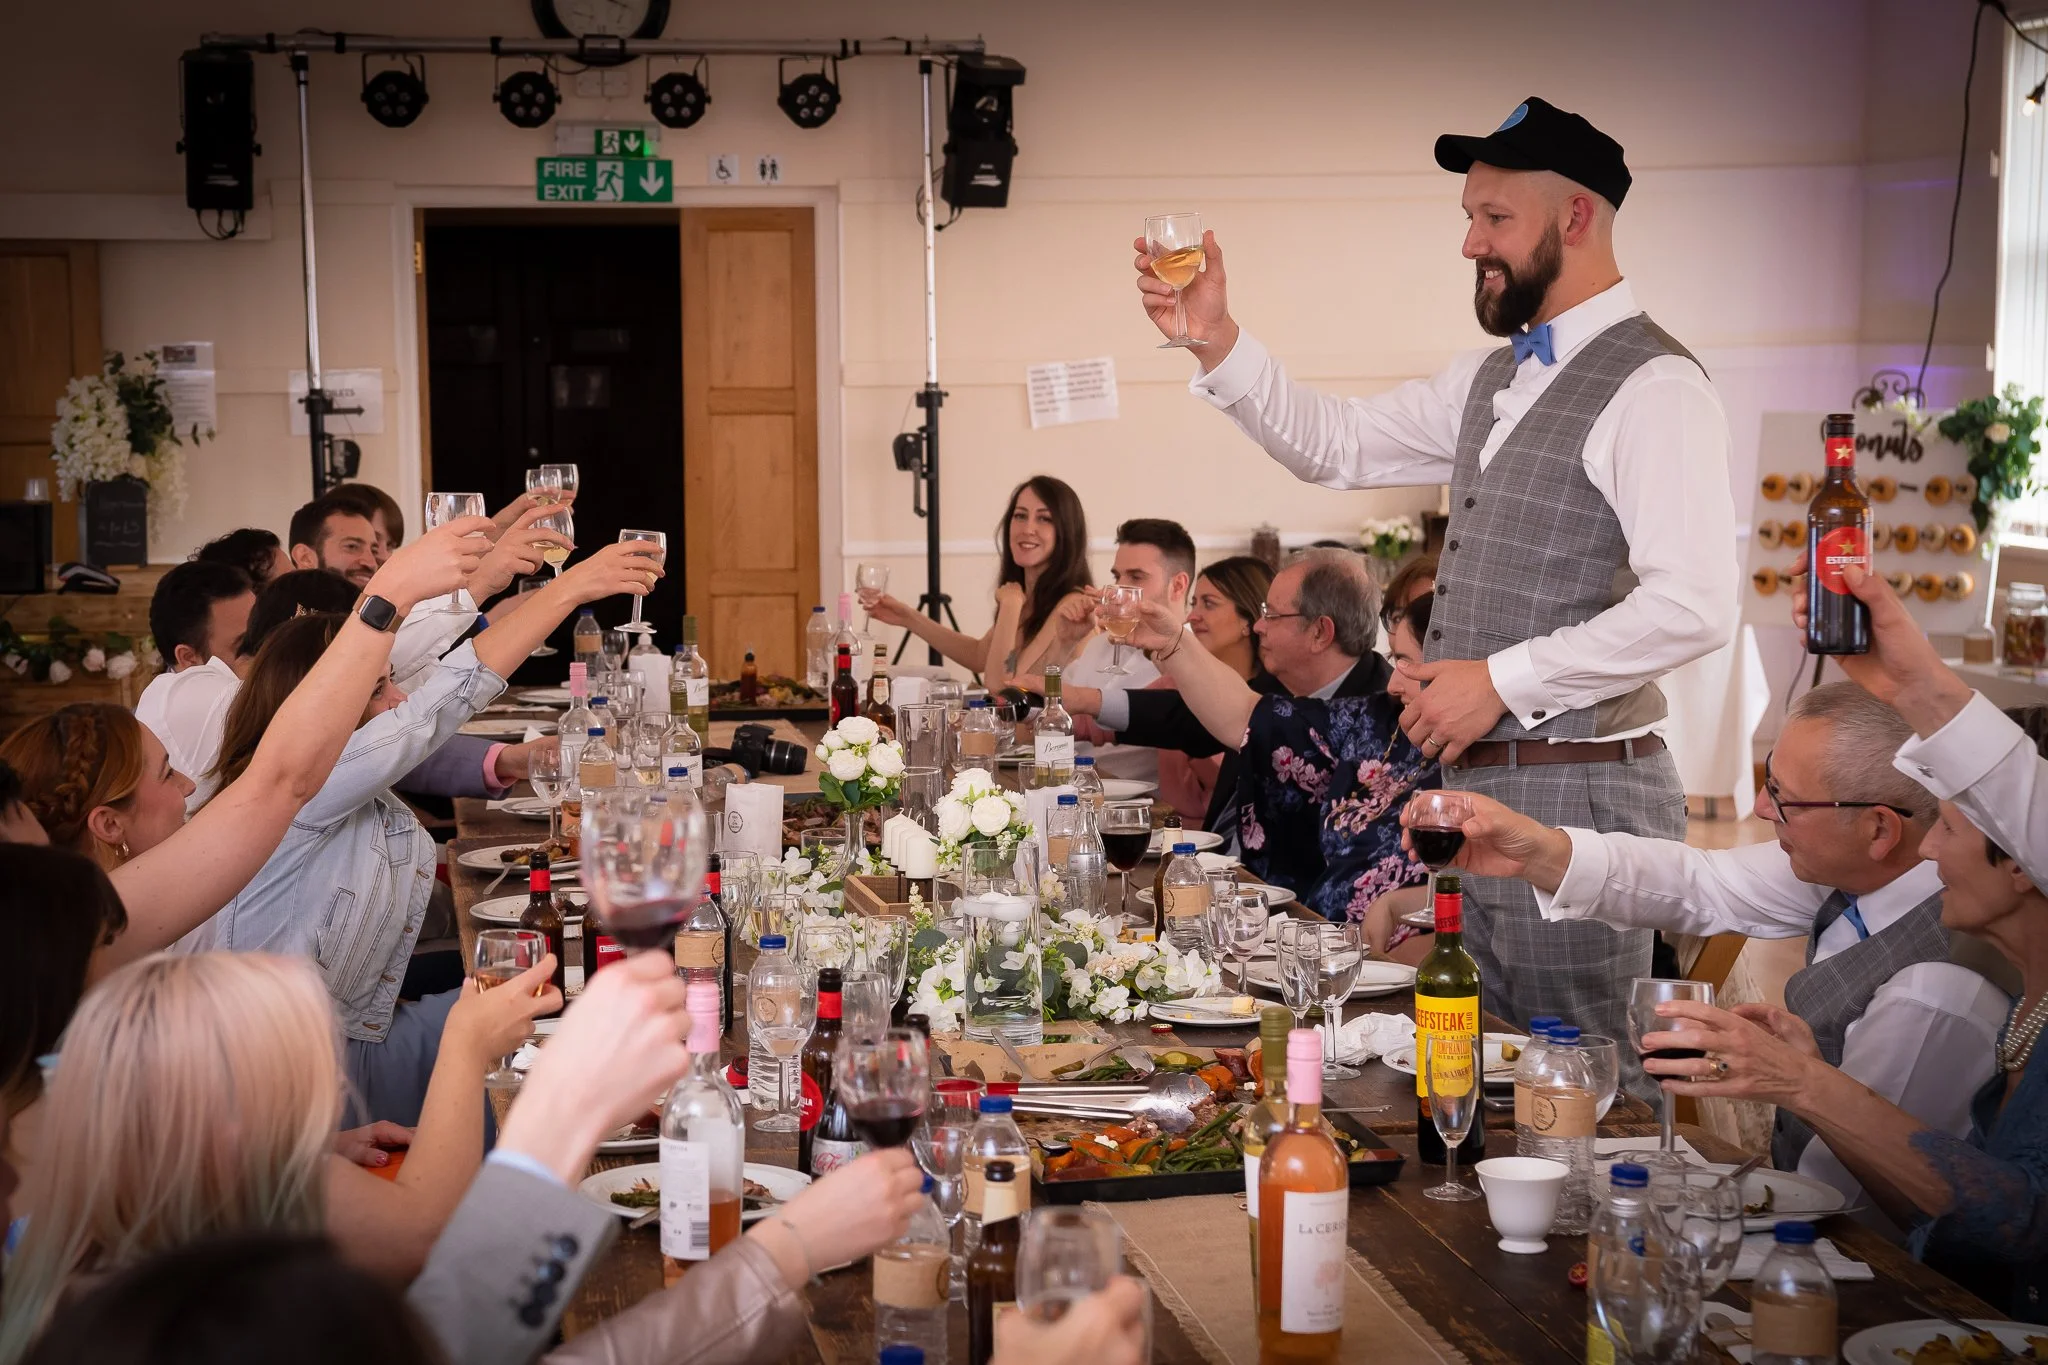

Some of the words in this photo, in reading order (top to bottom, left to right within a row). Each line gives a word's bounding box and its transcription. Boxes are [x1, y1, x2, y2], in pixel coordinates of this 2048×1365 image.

[543, 161, 587, 177] FIRE
[543, 184, 587, 200] EXIT
[326, 388, 355, 397] OILETS
[1820, 417, 1925, 463] onuts
[1416, 1008, 1465, 1031] EEFSTEAK
